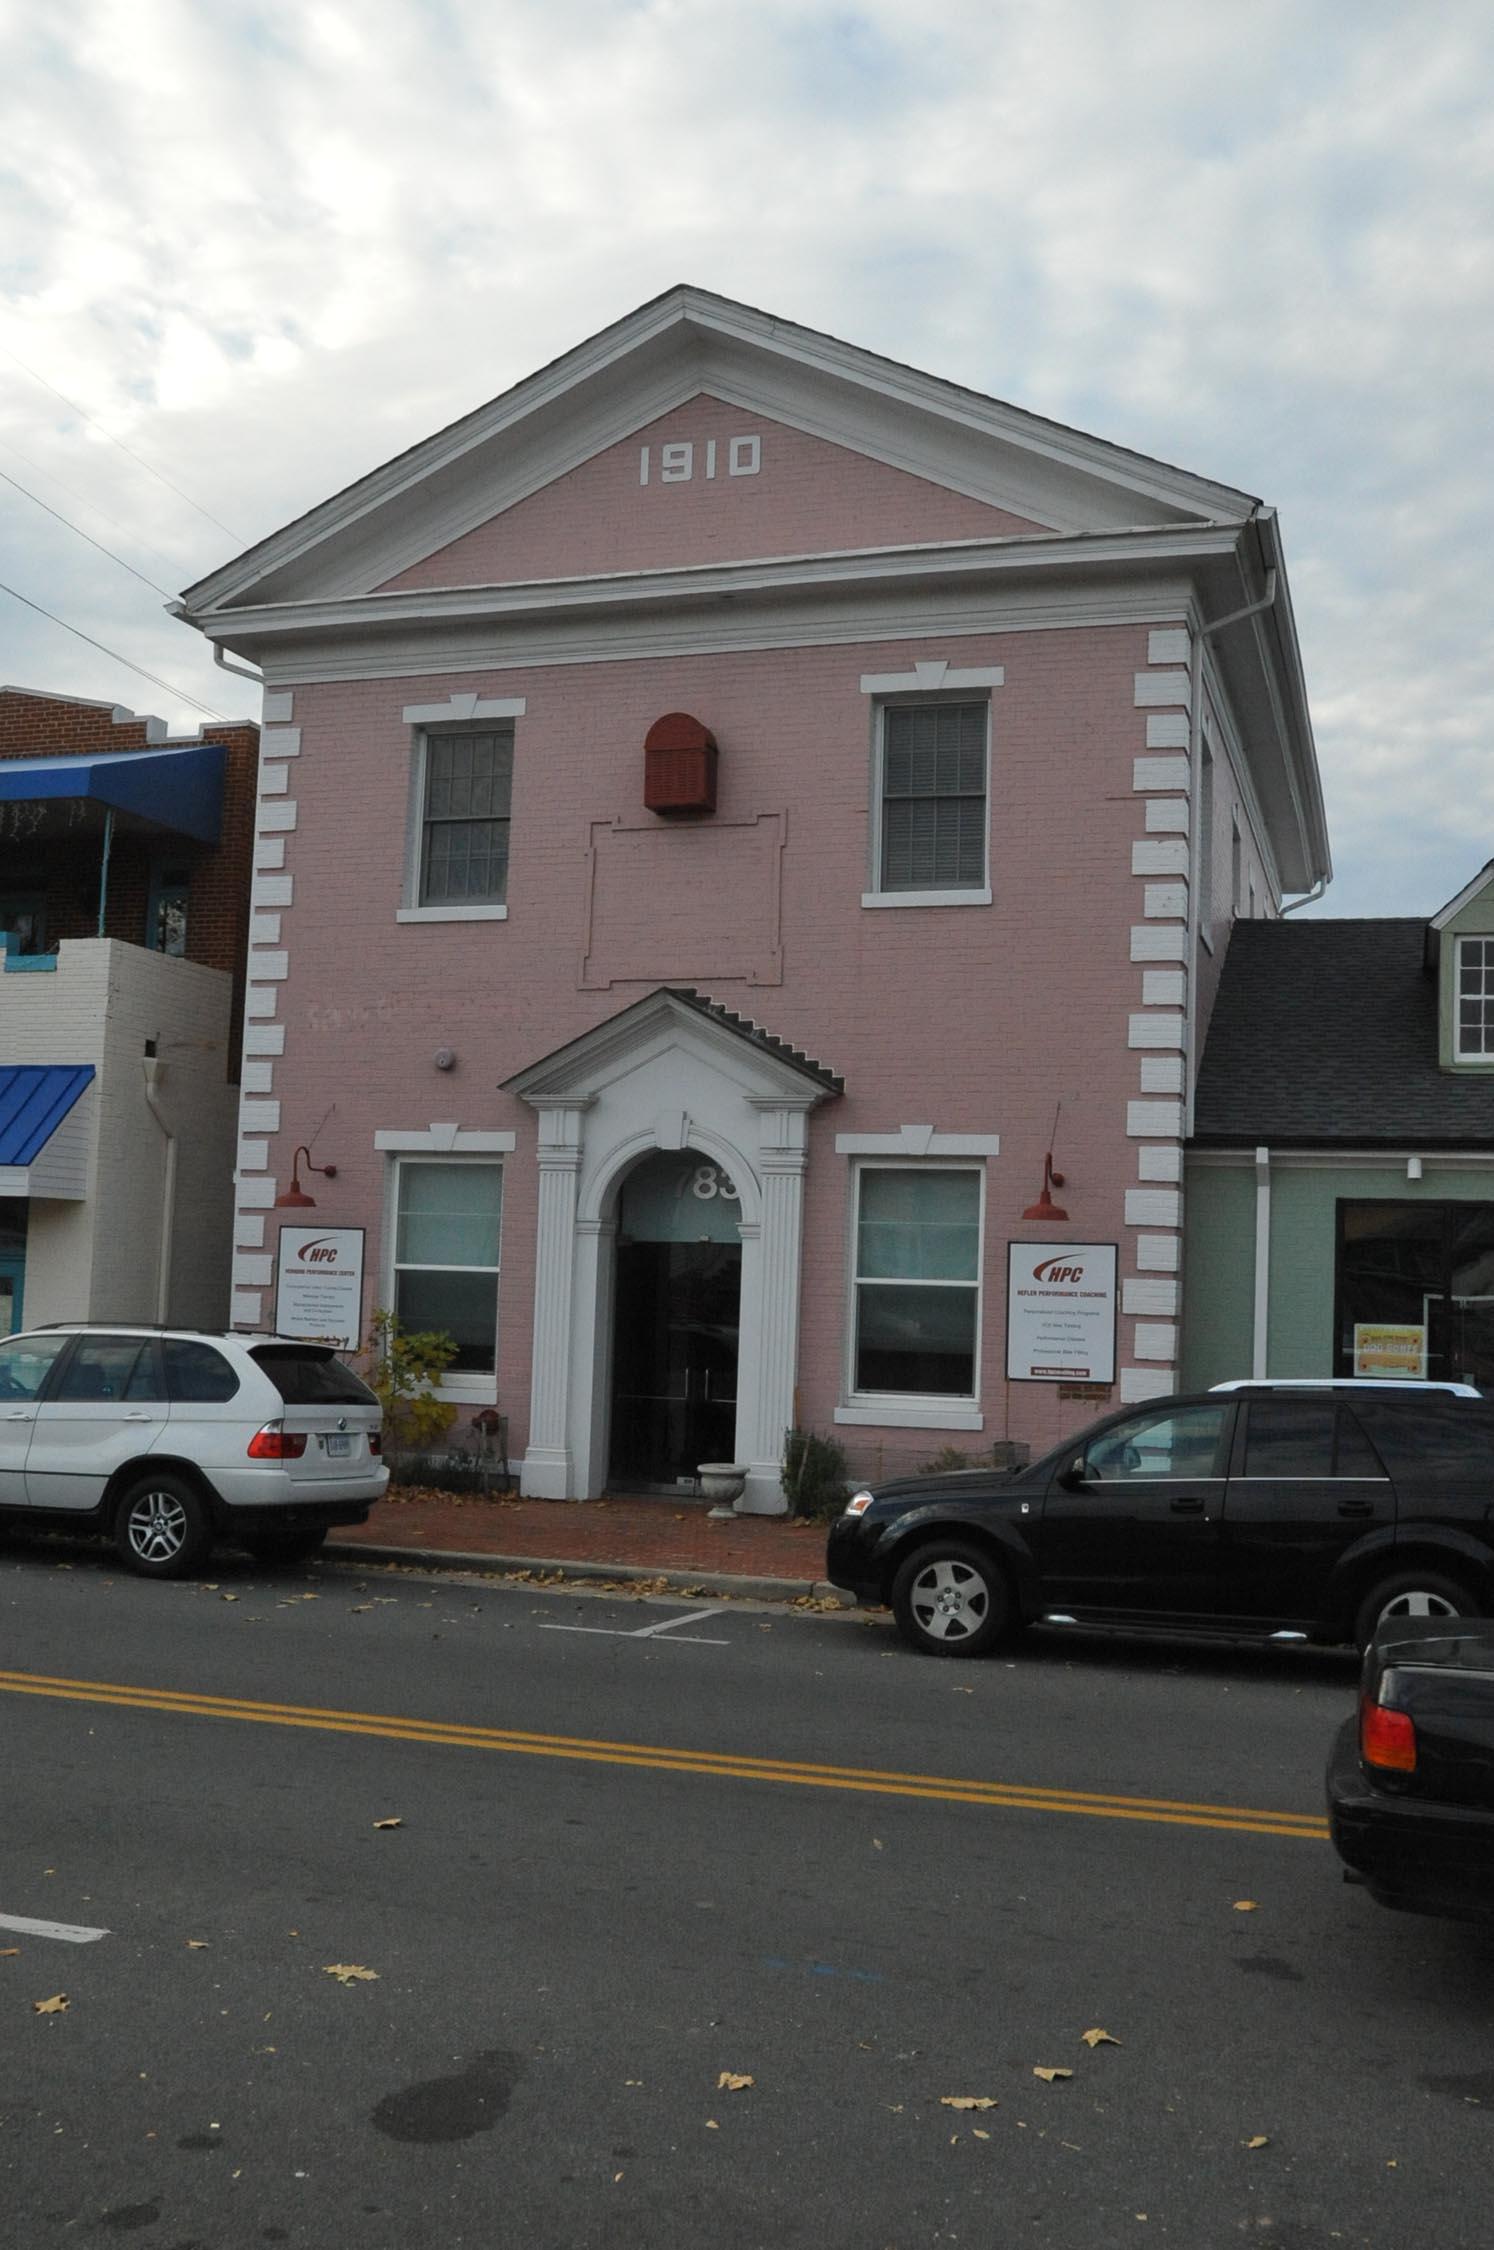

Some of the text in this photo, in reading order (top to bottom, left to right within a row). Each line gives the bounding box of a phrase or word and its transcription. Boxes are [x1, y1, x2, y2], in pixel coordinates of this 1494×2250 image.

[640, 435, 761, 486] 1910
[309, 1248, 338, 1263] HPC
[1047, 1266, 1084, 1283] HPC
[1038, 1290, 1078, 1298] PERFORMANCE
[1080, 1291, 1107, 1299] COACHING
